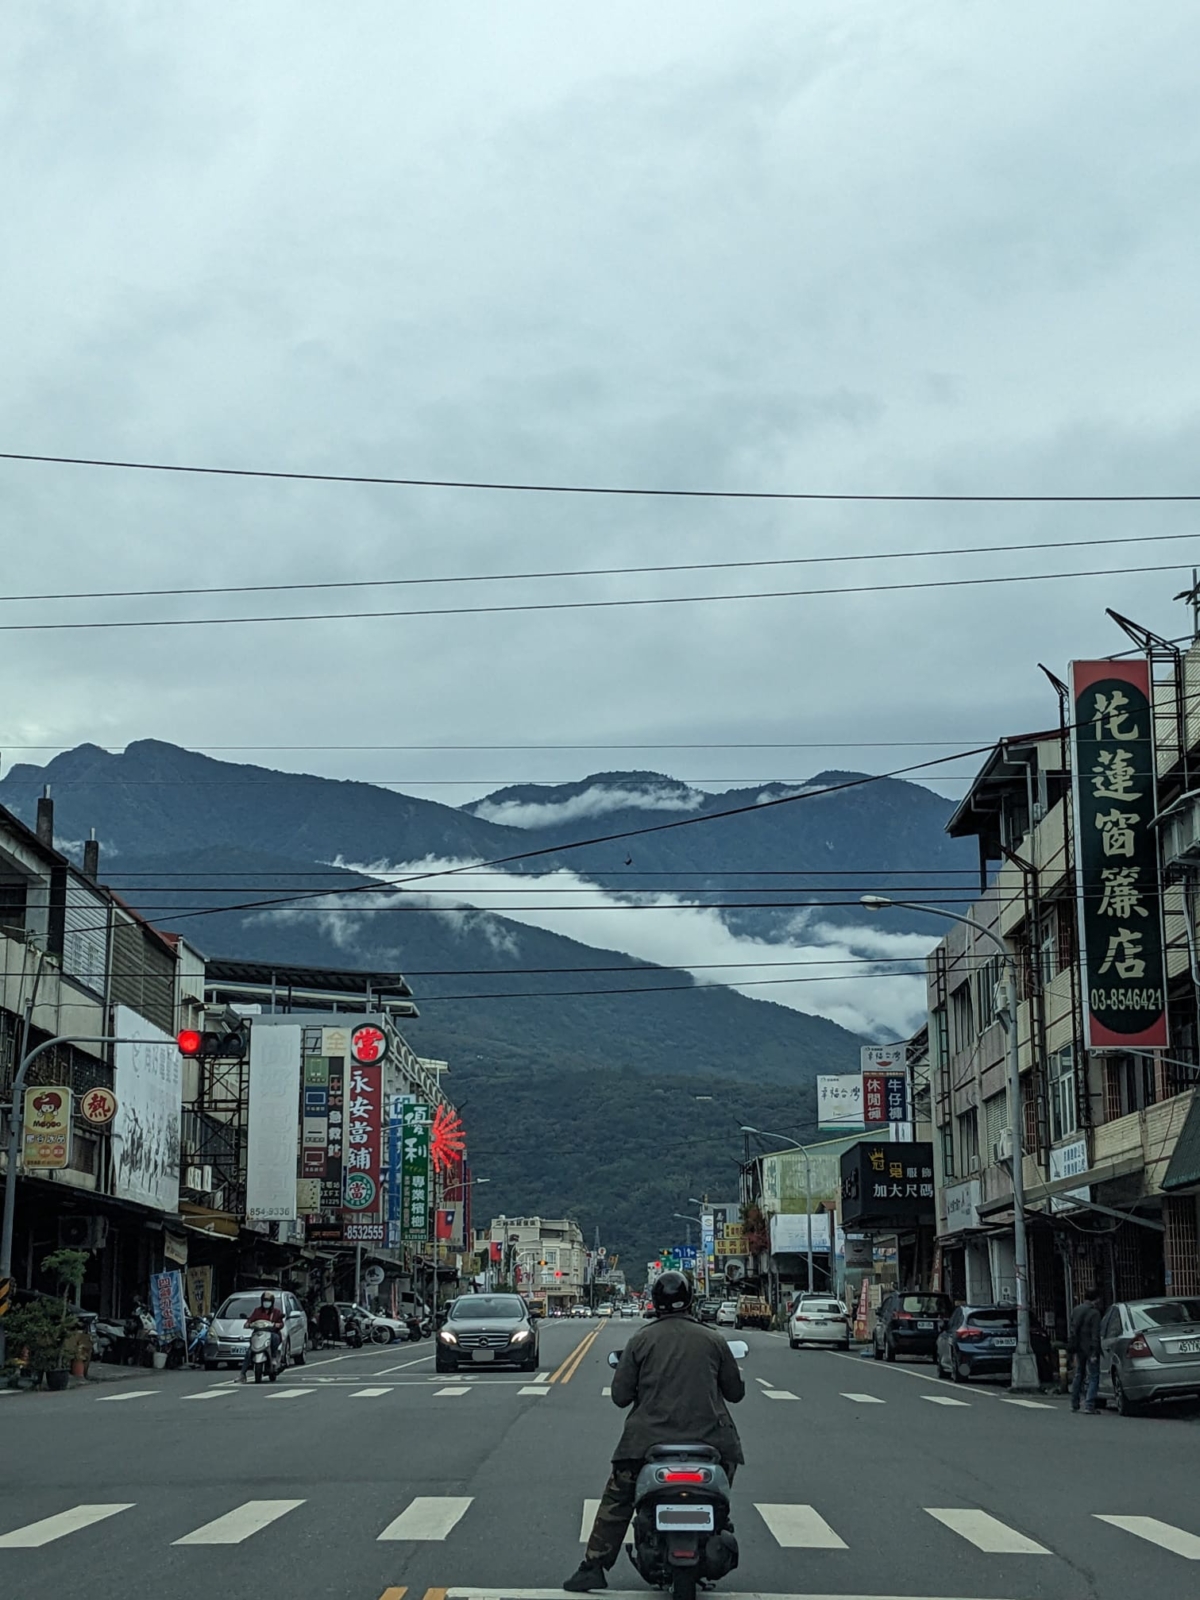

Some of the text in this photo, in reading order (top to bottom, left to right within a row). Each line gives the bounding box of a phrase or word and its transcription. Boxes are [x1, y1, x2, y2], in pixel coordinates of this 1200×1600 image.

[1090, 690, 1149, 979] 花蓮窗簾店
[1091, 988, 1162, 1011] 03-8546421
[353, 1027, 384, 1062] 當
[88, 1093, 112, 1118] 熱
[404, 1106, 427, 1163] 優利
[411, 1175, 426, 1228] 專業檳榔
[873, 1183, 933, 1198] 加大尺碼
